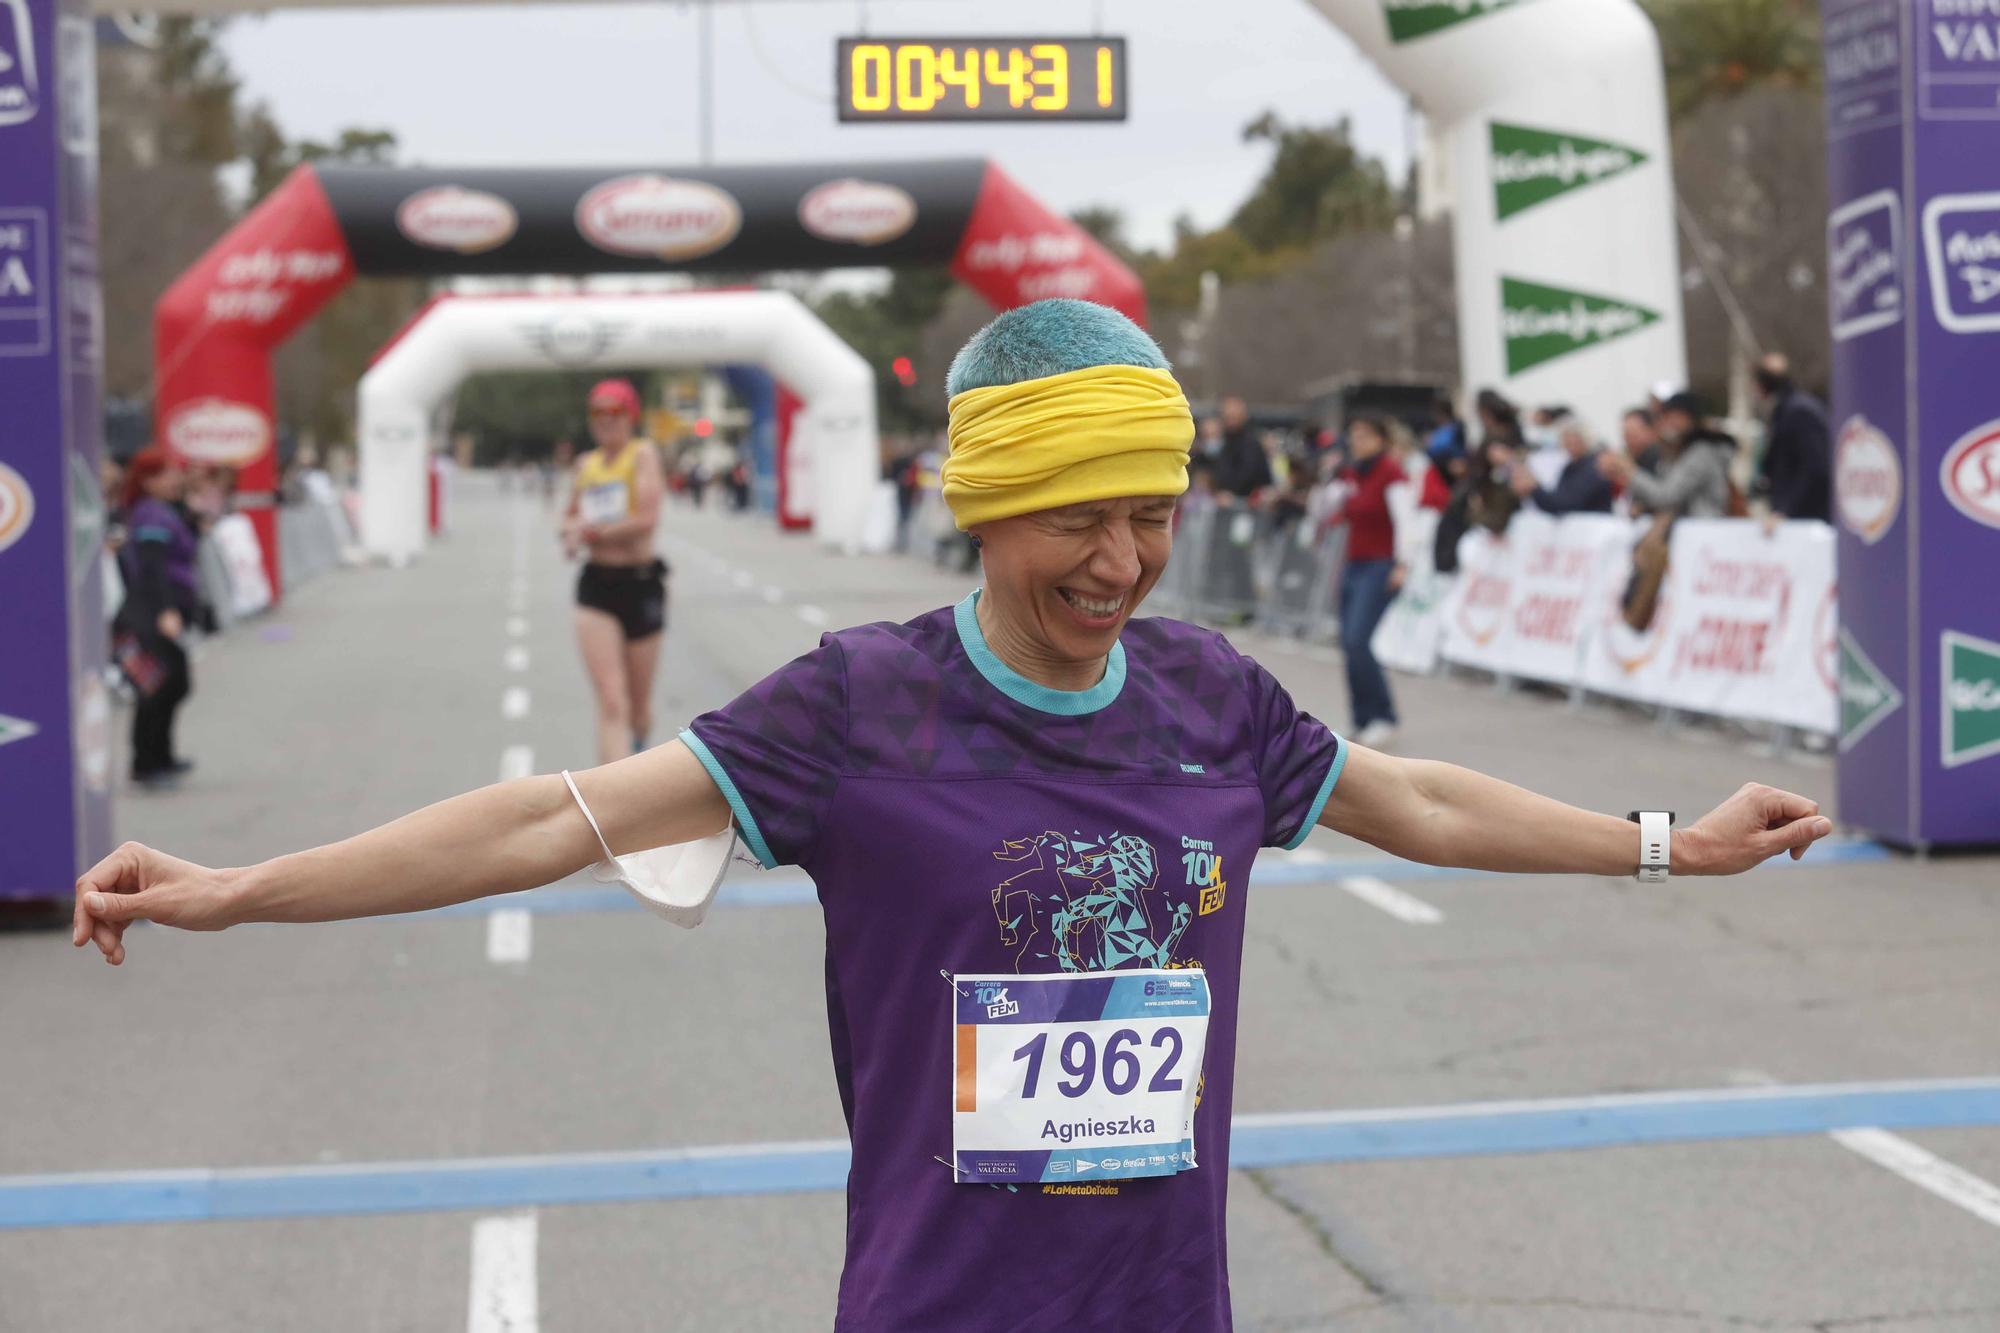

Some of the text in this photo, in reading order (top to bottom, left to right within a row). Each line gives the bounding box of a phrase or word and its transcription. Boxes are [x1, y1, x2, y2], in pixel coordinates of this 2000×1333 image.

[1181, 835, 1213, 851] Carrera
[1181, 851, 1222, 887] 10K
[1201, 887, 1225, 912] FEM
[975, 988, 1008, 1004] 10K
[1144, 980, 1155, 996] 6
[990, 1003, 1016, 1016] FEM
[1012, 1026, 1183, 1099] 1962
[1040, 1115, 1155, 1143] Agnieszka
[1042, 1184, 1119, 1196] #LaMetaDeTodos
